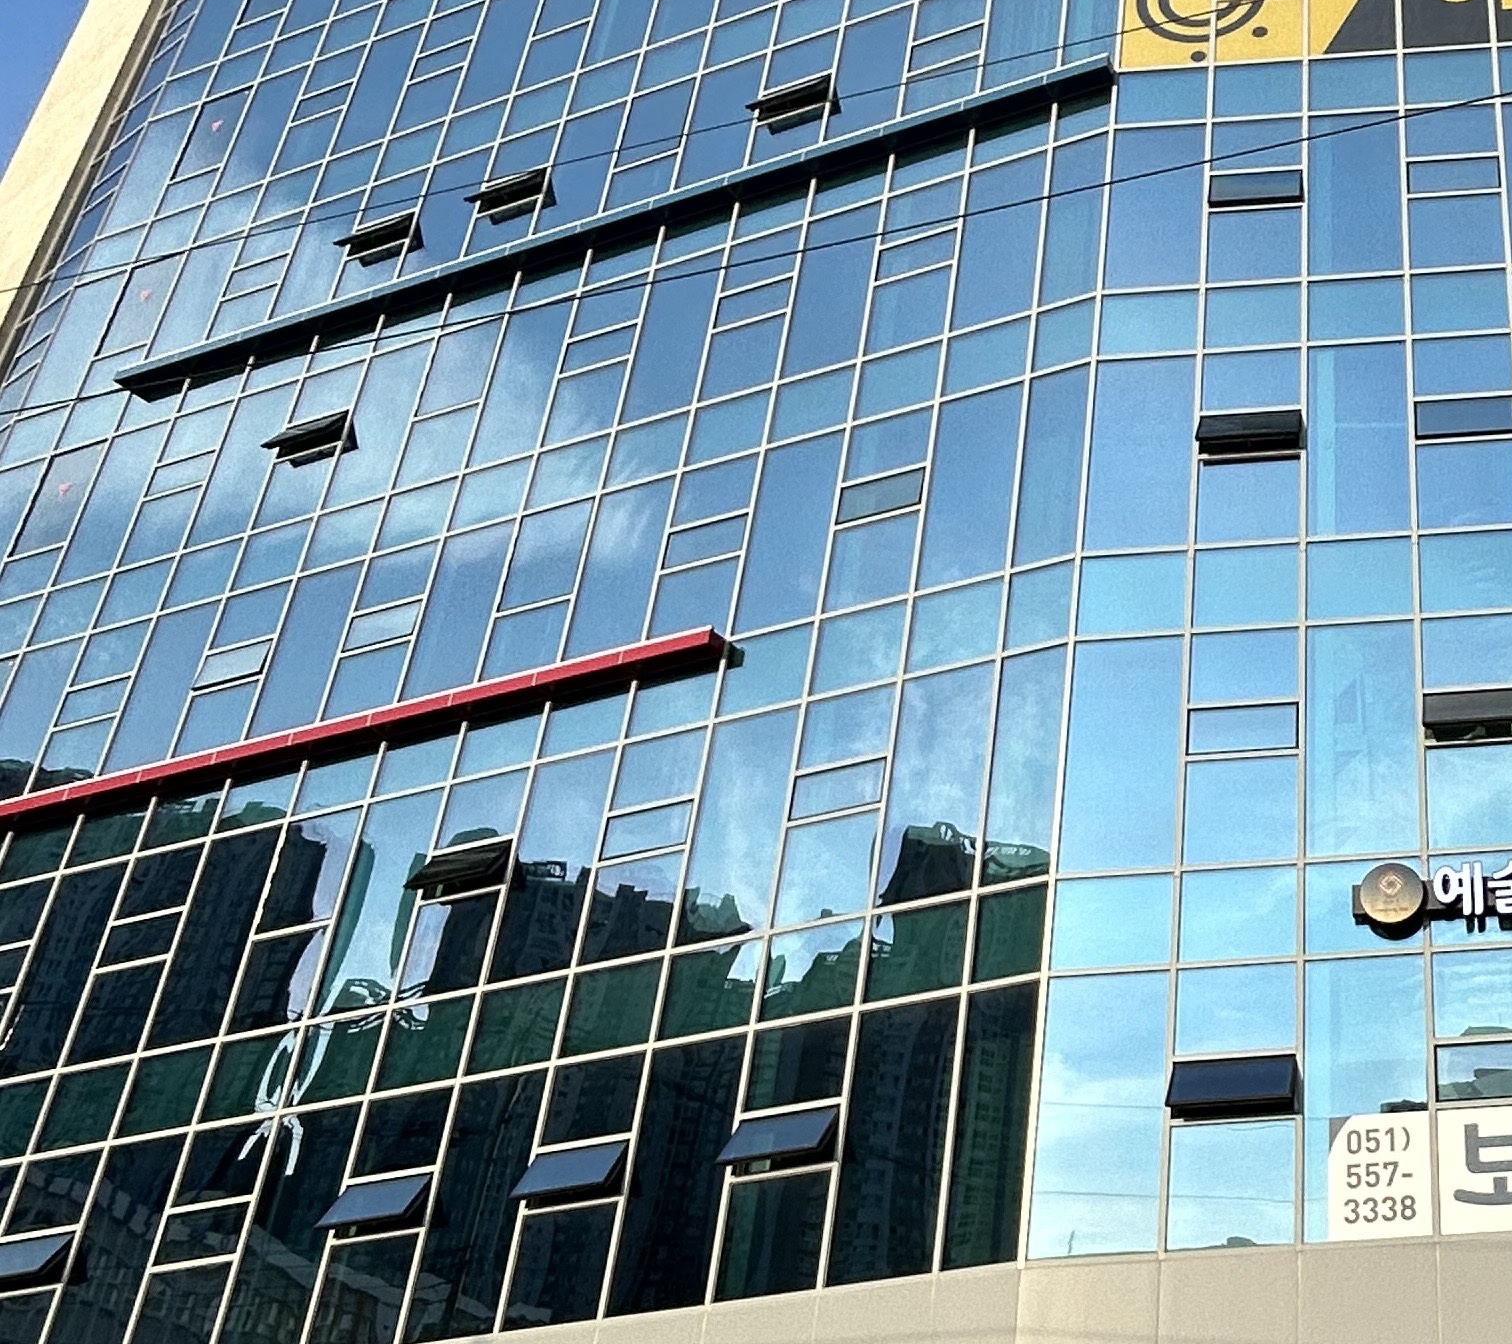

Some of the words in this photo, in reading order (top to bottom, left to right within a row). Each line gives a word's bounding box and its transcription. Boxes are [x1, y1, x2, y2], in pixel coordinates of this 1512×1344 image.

[1345, 1127, 1411, 1156] 051)
[1345, 1161, 1413, 1189] 557-
[1344, 1195, 1417, 1224] 3338
